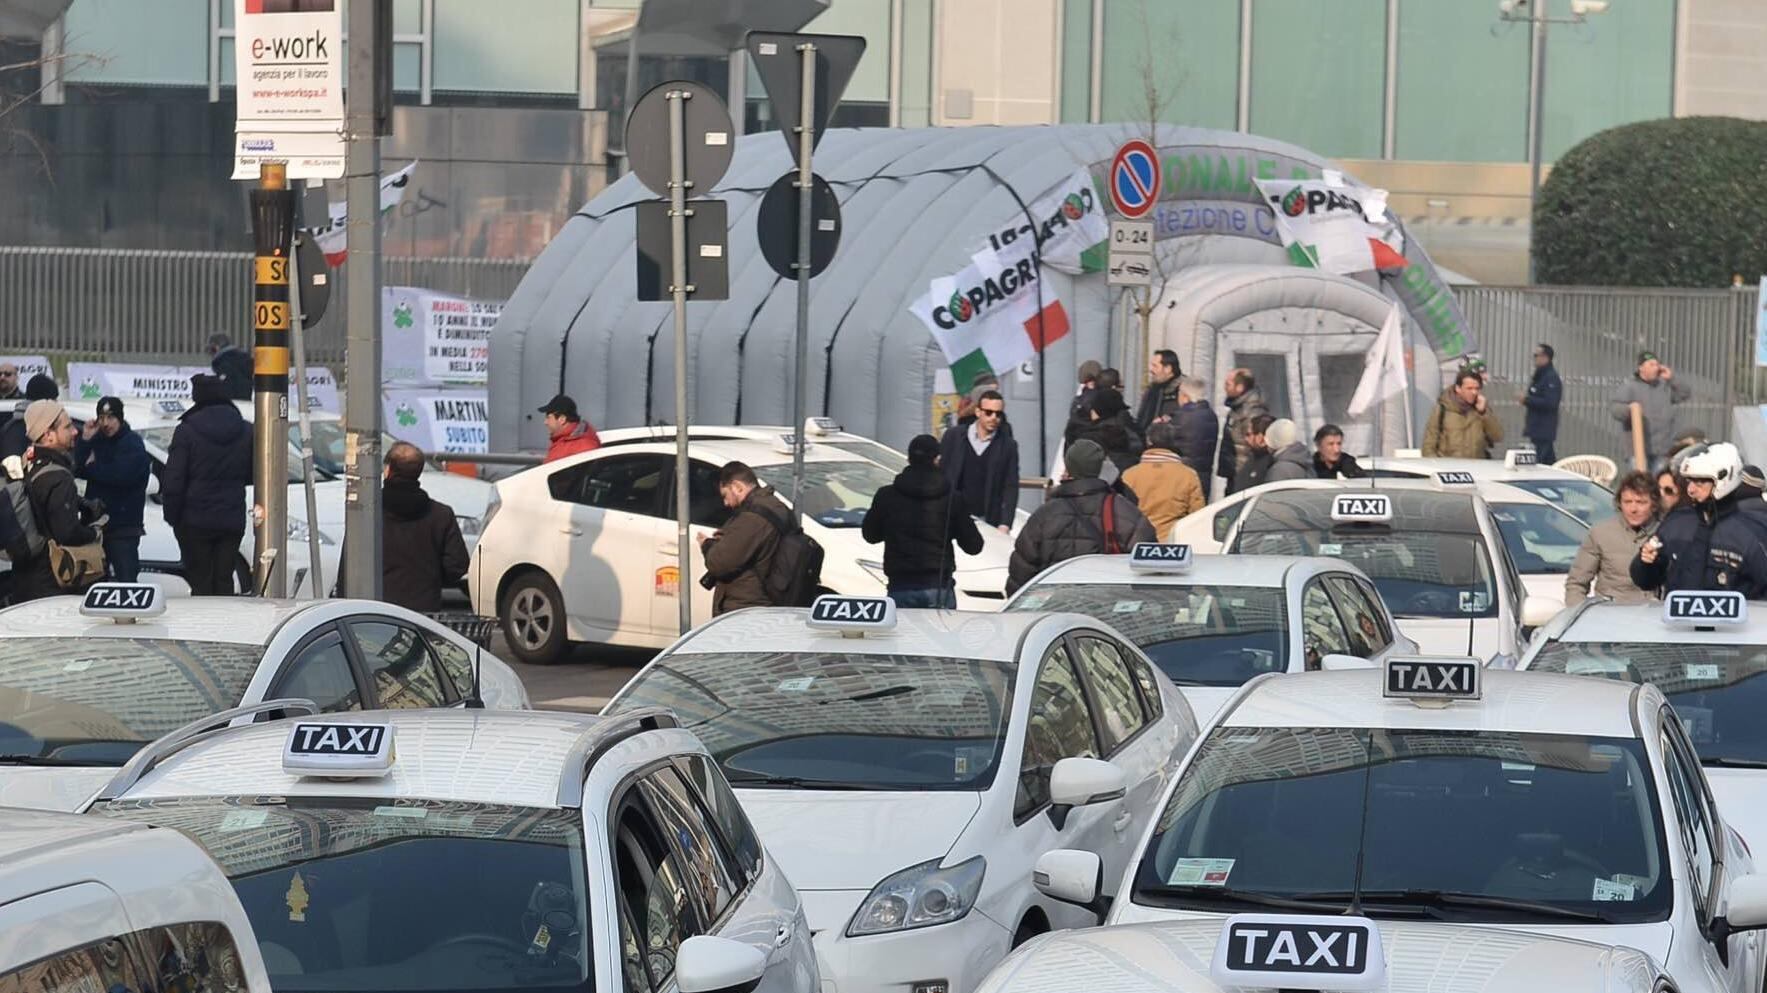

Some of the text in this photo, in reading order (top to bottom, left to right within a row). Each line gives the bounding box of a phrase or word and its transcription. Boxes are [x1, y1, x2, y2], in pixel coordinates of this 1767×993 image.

[252, 29, 329, 60] e-work
[253, 69, 281, 81] agenzia
[283, 70, 296, 80] per
[304, 68, 328, 79] lavoro
[255, 305, 281, 326] OS
[133, 377, 189, 391] MINISTRO
[446, 426, 486, 443] SUBITO
[1441, 473, 1474, 483] TAXI
[1341, 499, 1385, 514] TAXI
[1138, 546, 1185, 558] TAXI
[93, 588, 151, 606] TAXI
[820, 600, 884, 619] TAXI
[1673, 597, 1736, 616] TAXI
[1392, 665, 1471, 691] TAXI
[299, 726, 380, 752] TAXI
[1235, 929, 1358, 967] TAXI
